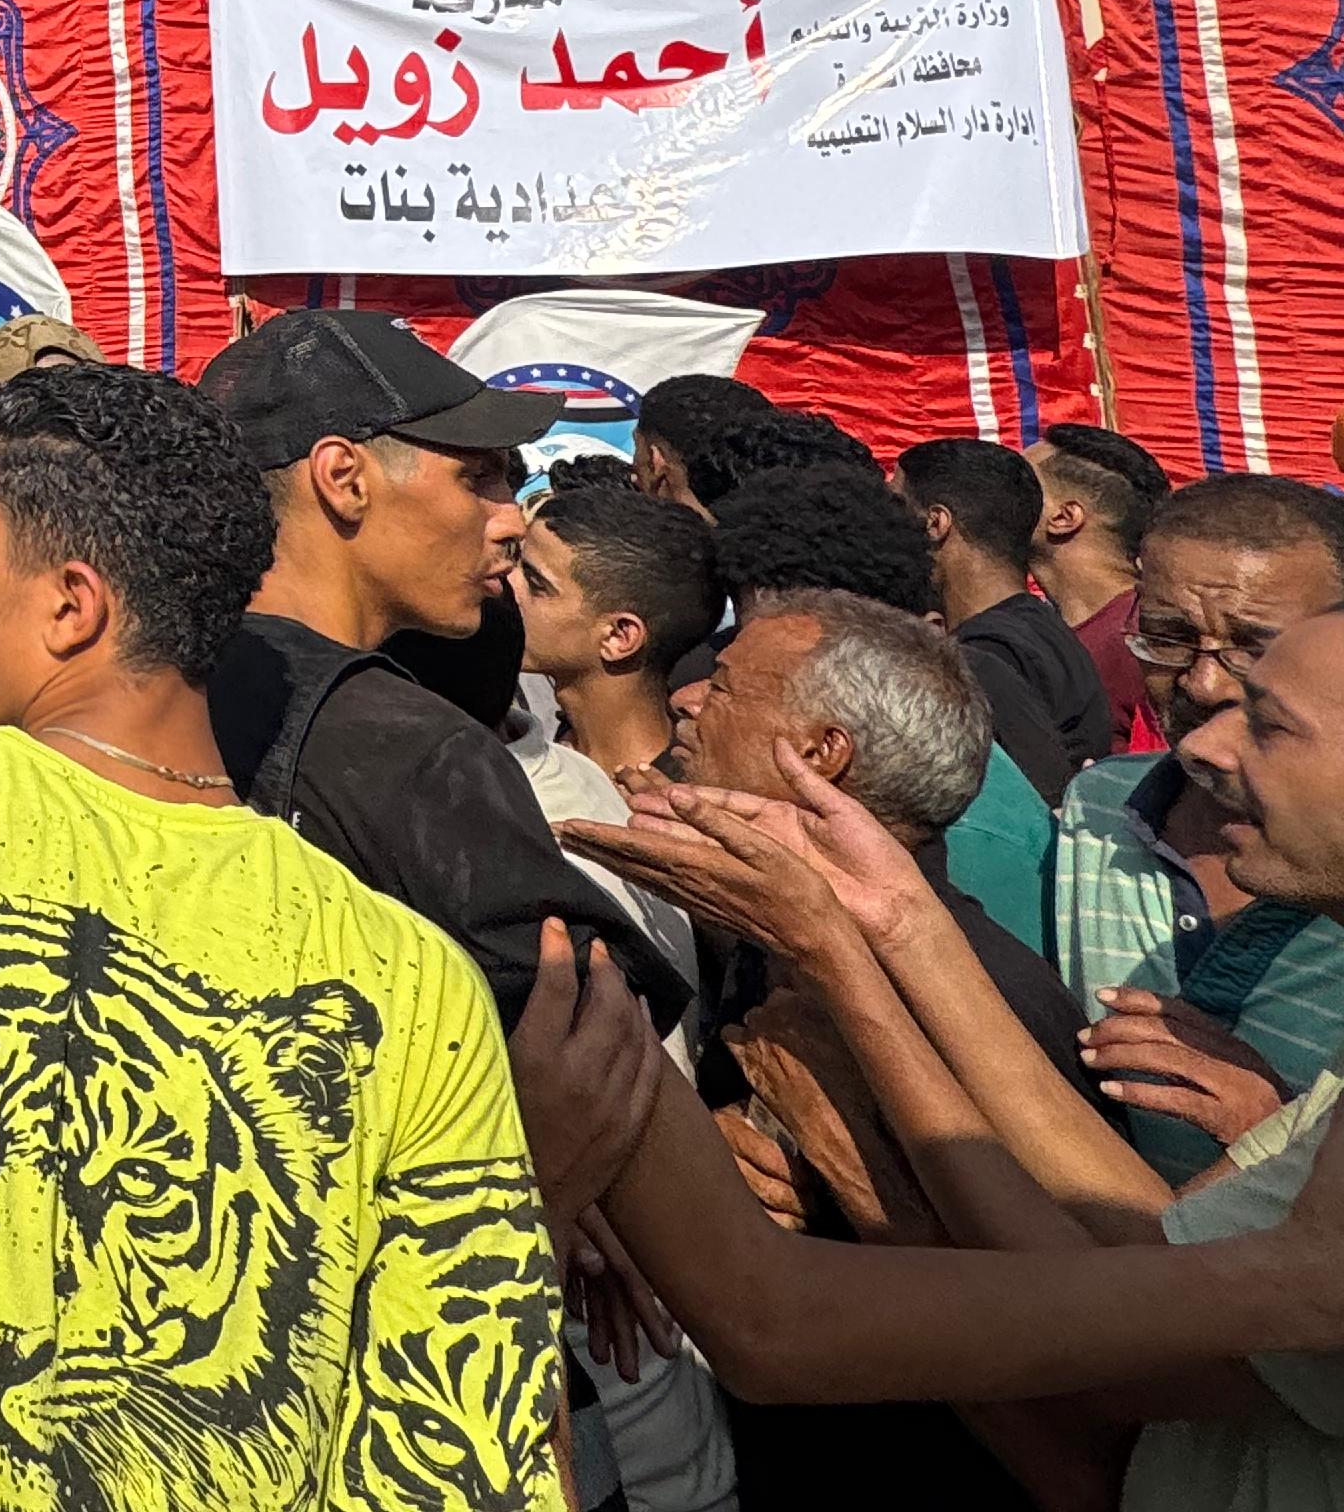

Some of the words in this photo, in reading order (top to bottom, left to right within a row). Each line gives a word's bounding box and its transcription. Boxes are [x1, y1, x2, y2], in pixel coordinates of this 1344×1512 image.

[790, 15, 872, 51] والتليم
[873, 6, 951, 39] التربية
[261, 20, 481, 146] زويل
[911, 49, 983, 83] محافظة
[896, 104, 956, 148] السلام
[961, 103, 990, 141] دار
[990, 99, 1040, 147] إدارة
[340, 162, 436, 243] بنات
[446, 162, 639, 244] عدادية
